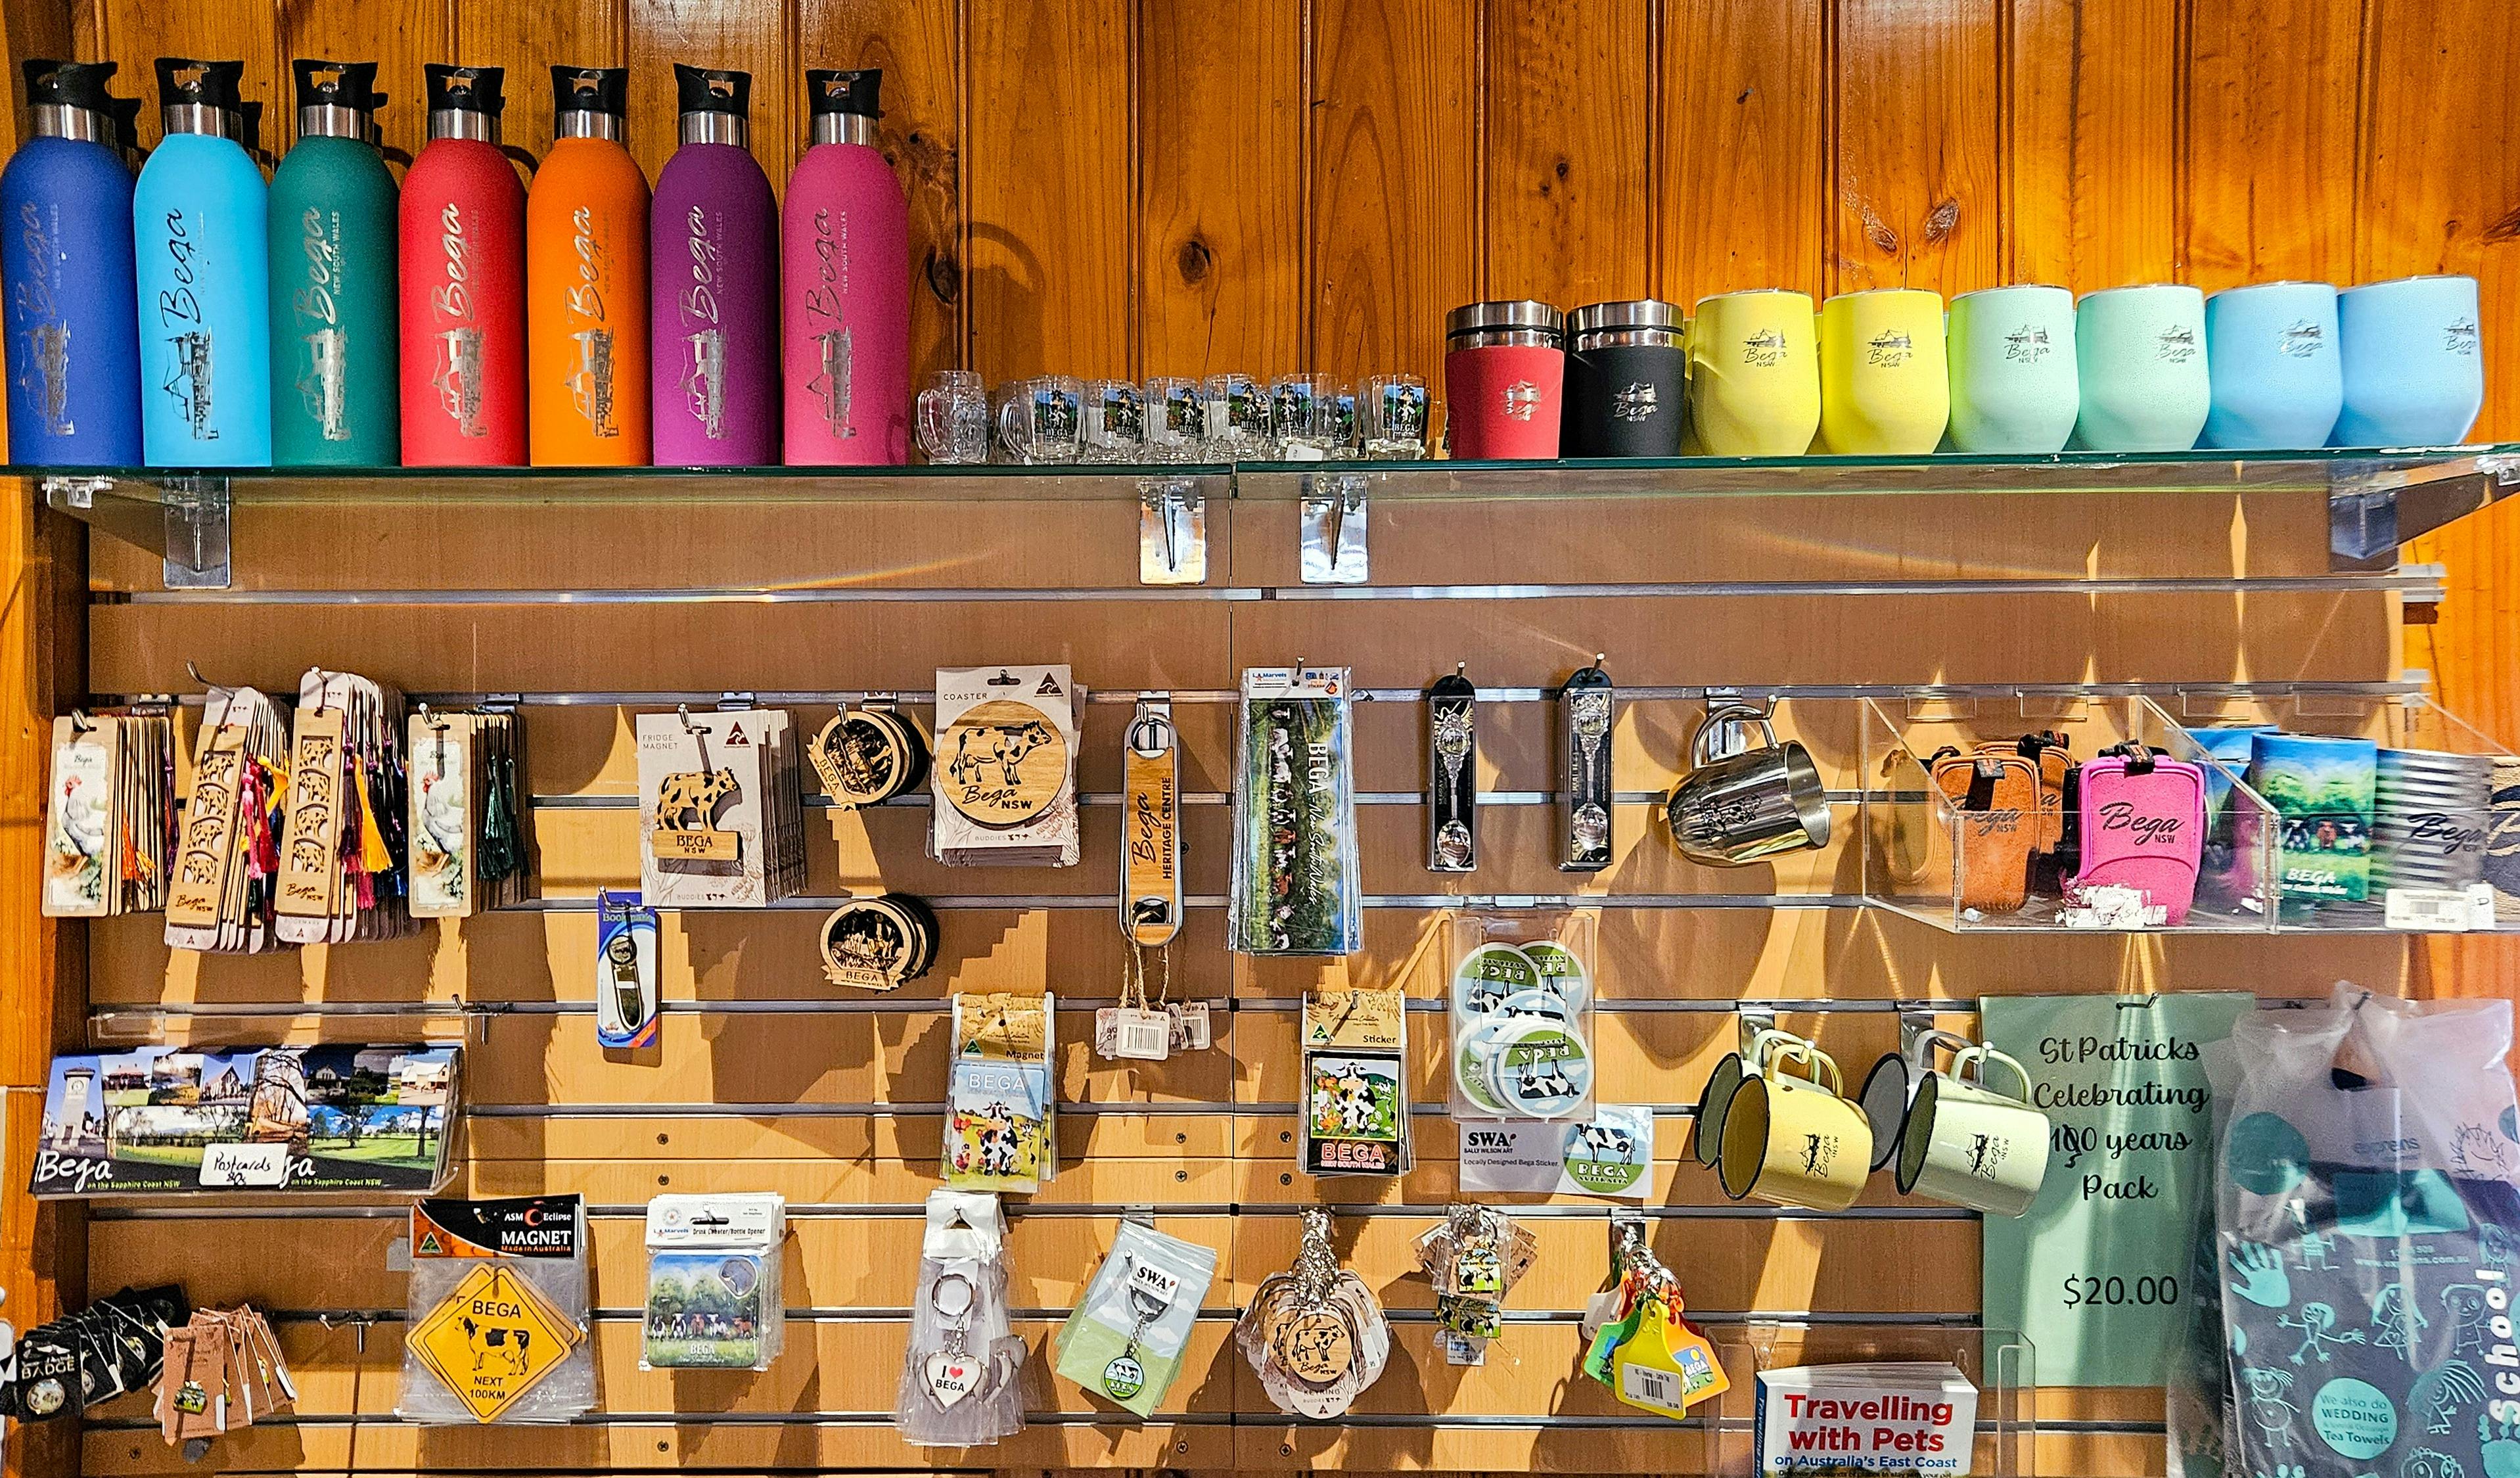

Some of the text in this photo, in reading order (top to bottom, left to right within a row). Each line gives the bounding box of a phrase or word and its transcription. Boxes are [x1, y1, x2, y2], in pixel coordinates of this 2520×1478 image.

[160, 208, 200, 328] Bega
[292, 206, 336, 326] Bega
[431, 202, 473, 323] Bega
[564, 206, 605, 324] Bega
[679, 206, 718, 327] Bega
[805, 207, 843, 327] Bega
[1743, 348, 1788, 363] Bega
[1866, 348, 1913, 364] Bega
[2004, 344, 2050, 359] Bega
[1614, 402, 1659, 417] Bega
[943, 692, 988, 701] COASTER
[819, 758, 840, 790] BEGA
[1308, 743, 1329, 794] BEGA
[961, 785, 1018, 808] Bega
[1001, 800, 1033, 810] NSW
[1308, 804, 1325, 829] New
[2099, 801, 2184, 846] Bega
[1132, 791, 1162, 867] Bega
[1162, 777, 1172, 879] HERITAGE CENTRE
[1997, 825, 2017, 833] NSW
[2407, 812, 2482, 855] Bega
[676, 833, 713, 848] BEGA
[2155, 833, 2175, 844] NSW
[683, 846, 706, 854] NSW
[2285, 867, 2337, 885] BEGA
[286, 883, 317, 898] Bega
[175, 894, 206, 910] Bega
[846, 971, 879, 982] BEGA
[1363, 1034, 1397, 1044] Sticker
[1005, 1050, 1045, 1060] Magnet
[2039, 1036, 2200, 1065] St Patricks
[969, 1073, 1026, 1092] BEGA
[2033, 1082, 2211, 1113] Celebrating
[1468, 1132, 1510, 1147] SWA
[2106, 1130, 2193, 1159] years
[1321, 1142, 1386, 1163] BEGA
[1813, 1136, 1831, 1178] Bega
[1980, 1136, 2000, 1180] Bega
[214, 1151, 271, 1172] Postcards
[1577, 1162, 1629, 1178] BEGA
[34, 1149, 113, 1193] Bega
[97, 1181, 110, 1189] the
[110, 1181, 141, 1189] Sapphire
[164, 1180, 181, 1189] NSW
[313, 1178, 344, 1188] Sapphire
[365, 1178, 383, 1187] NSW
[2082, 1174, 2159, 1201] Pack
[504, 1212, 572, 1222] ASM Eclipse
[501, 1230, 572, 1246] MAGNET
[1137, 1266, 1166, 1290] SWA
[2063, 1273, 2179, 1310] $20.00
[472, 1300, 522, 1319] BEGA
[690, 1343, 716, 1355] BEGA
[2474, 1268, 2520, 1425] School
[21, 1356, 76, 1381] BADGE
[942, 1364, 948, 1378] I
[1299, 1362, 1329, 1374] Bega
[474, 1375, 503, 1386] NEXT
[935, 1378, 965, 1393] BEGA
[469, 1389, 506, 1401] 100KM
[1303, 1388, 1341, 1397] KEYRING
[1784, 1394, 1954, 1426] Travelling
[2320, 1395, 2387, 1409] We also do
[2321, 1408, 2389, 1423] WEDDING
[1788, 1425, 1945, 1452] with Pets
[2324, 1430, 2391, 1444] Tea Towels
[1774, 1455, 1957, 1468] on Australia's East Coast
